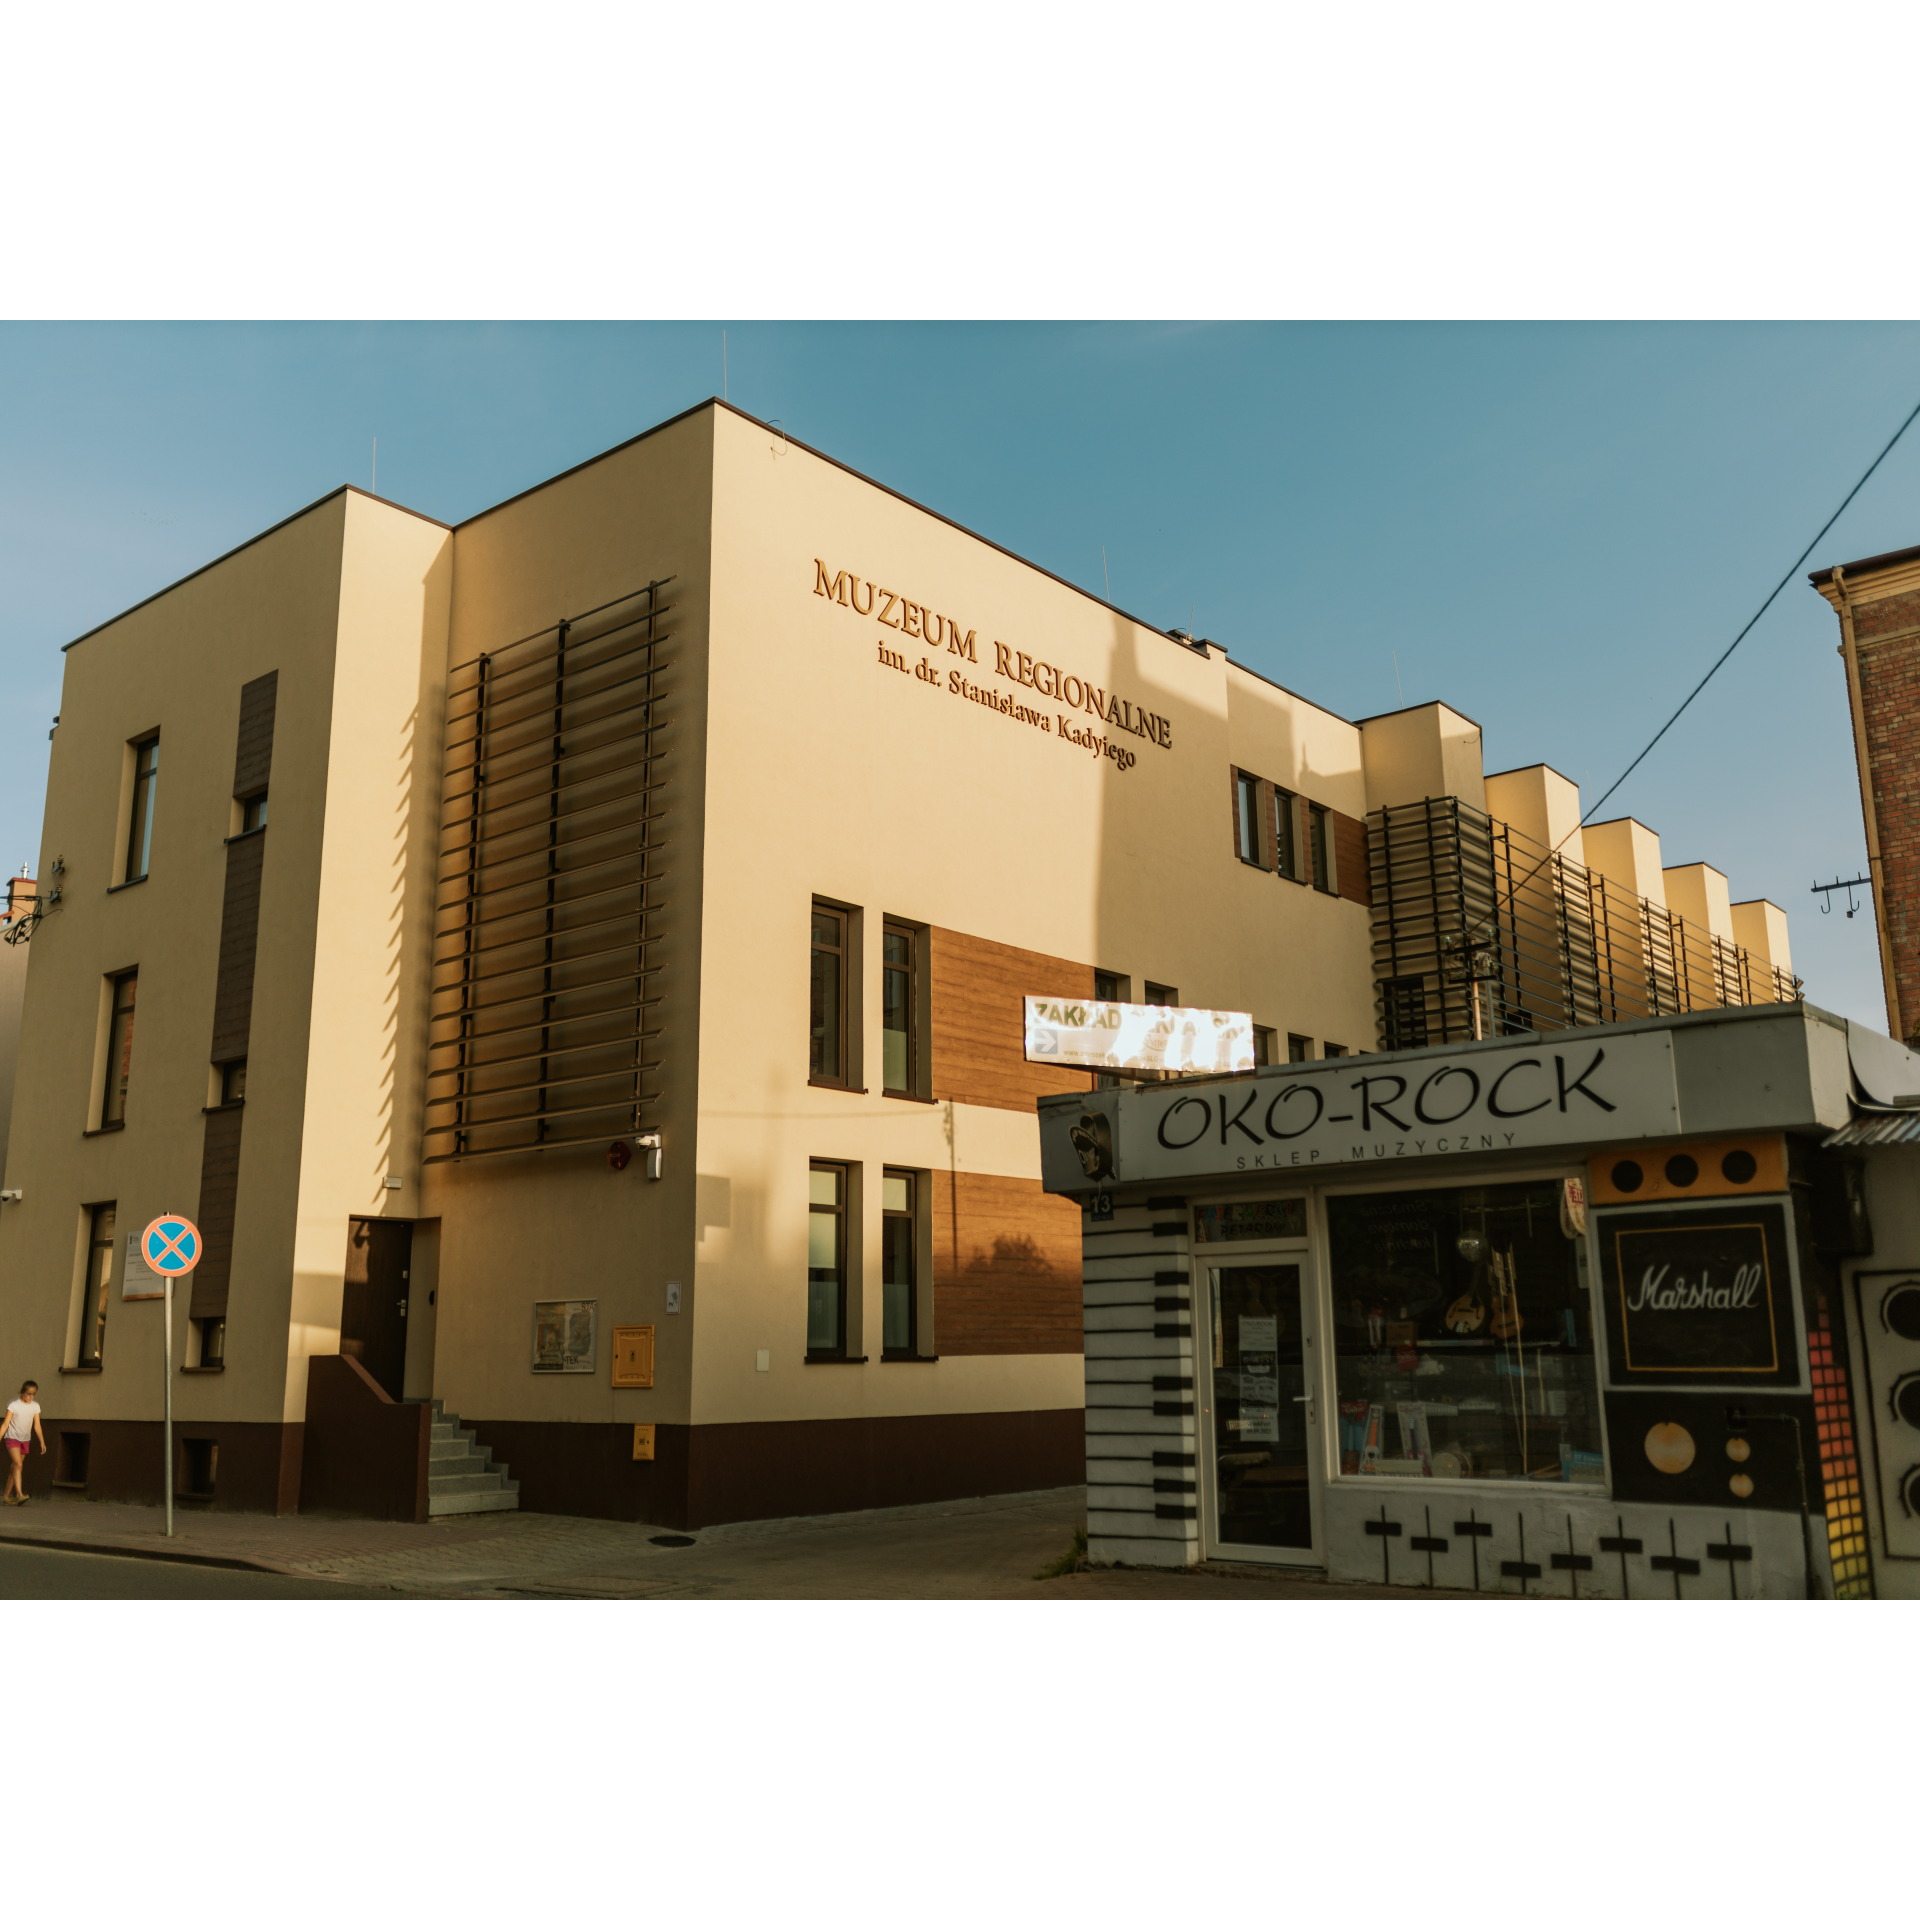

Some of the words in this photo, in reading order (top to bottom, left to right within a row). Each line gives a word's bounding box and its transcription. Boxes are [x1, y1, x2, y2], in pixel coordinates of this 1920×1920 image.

[813, 558, 978, 664] MUZEUM
[994, 640, 1173, 750] REGIONALNE
[878, 640, 911, 674] im.
[915, 657, 943, 688] dr.
[948, 670, 1052, 732] Stanisława
[1057, 714, 1137, 772] Kadyiego
[1156, 1047, 1618, 1150] OKO-ROCK
[1236, 1149, 1322, 1170] SKLEP
[1352, 1132, 1517, 1160] MUZYCZNY
[1091, 1194, 1111, 1214] 13
[1197, 1202, 1293, 1224] FAJERWERKI
[1220, 1221, 1282, 1237] PETARDY
[1627, 1263, 1762, 1312] Marshall
